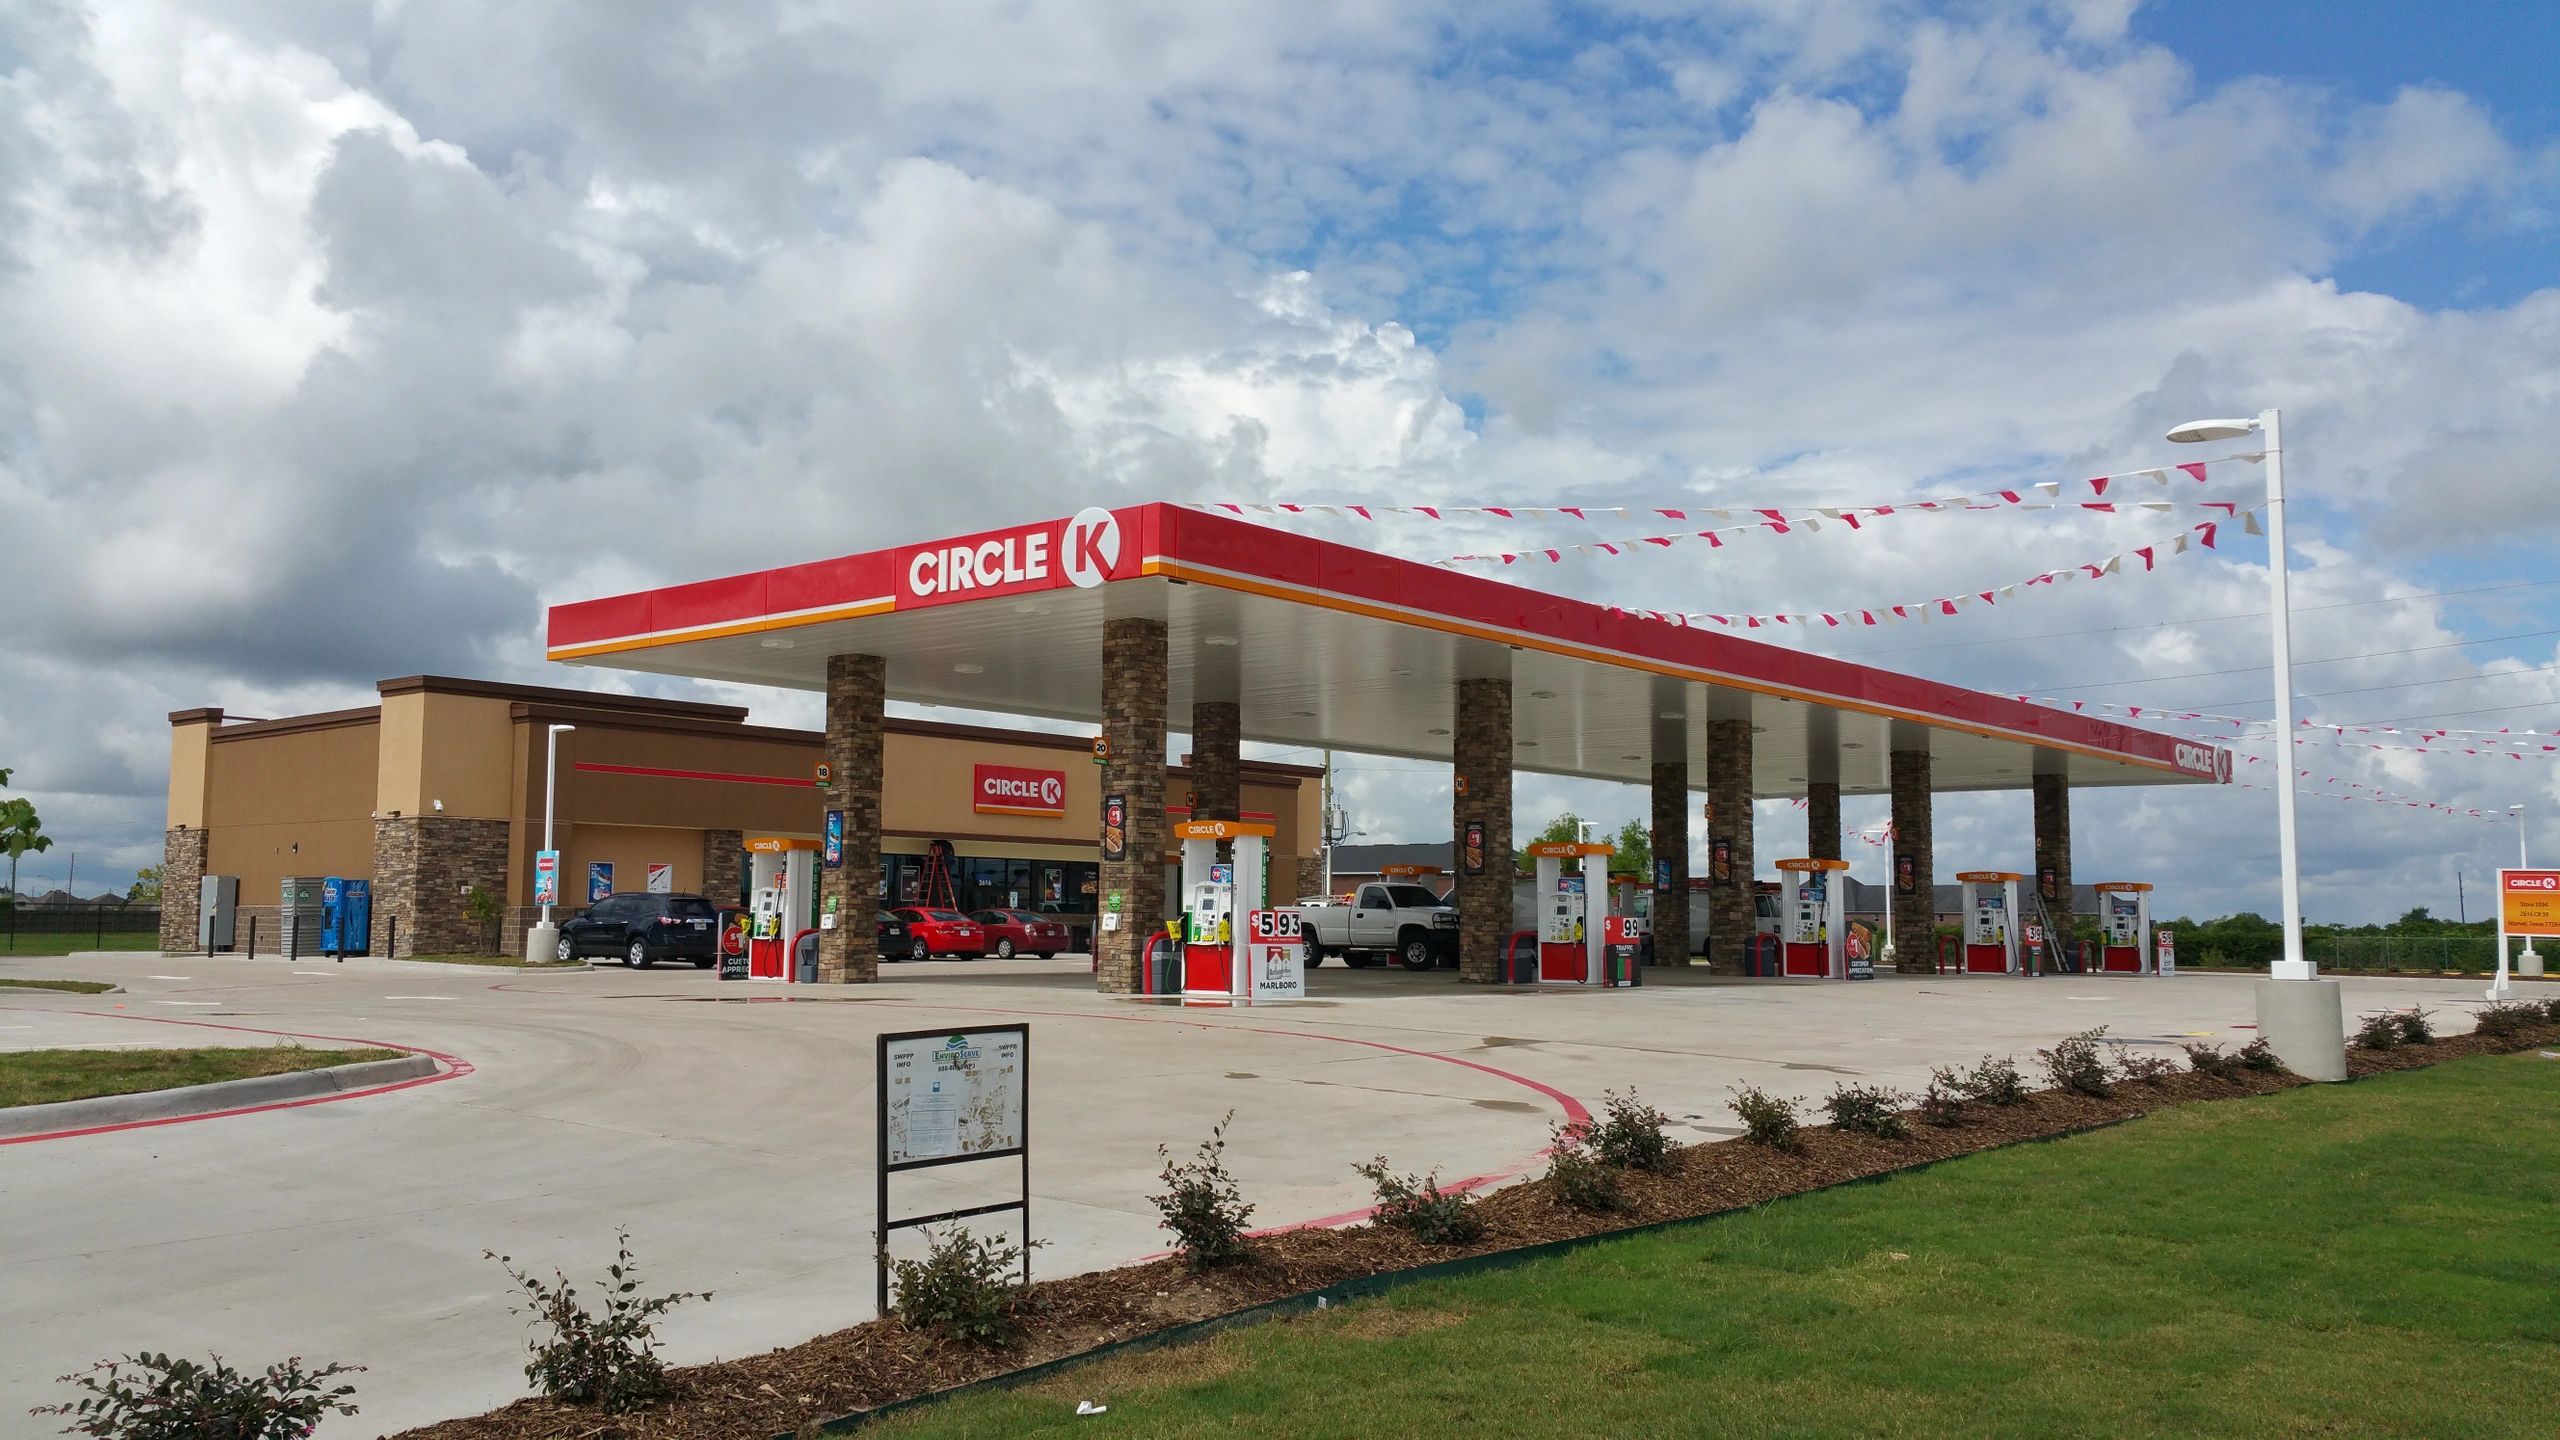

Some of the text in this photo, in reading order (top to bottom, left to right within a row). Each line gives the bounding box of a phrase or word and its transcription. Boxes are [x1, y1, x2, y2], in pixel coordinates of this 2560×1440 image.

[909, 518, 1116, 597] CIRCLE K
[1096, 743, 1106, 752] 20
[2175, 743, 2227, 781] CIRCLE K
[818, 767, 828, 777] 18
[984, 778, 1061, 802] CIRCLE K
[1188, 823, 1225, 836] CIRCLE K
[773, 841, 780, 851] K
[1567, 845, 1576, 855] K
[1811, 861, 1820, 870] K
[2510, 879, 2542, 887] CIRCLE
[1259, 981, 1298, 990] MARLBORO
[893, 1052, 914, 1061] SWPPP
